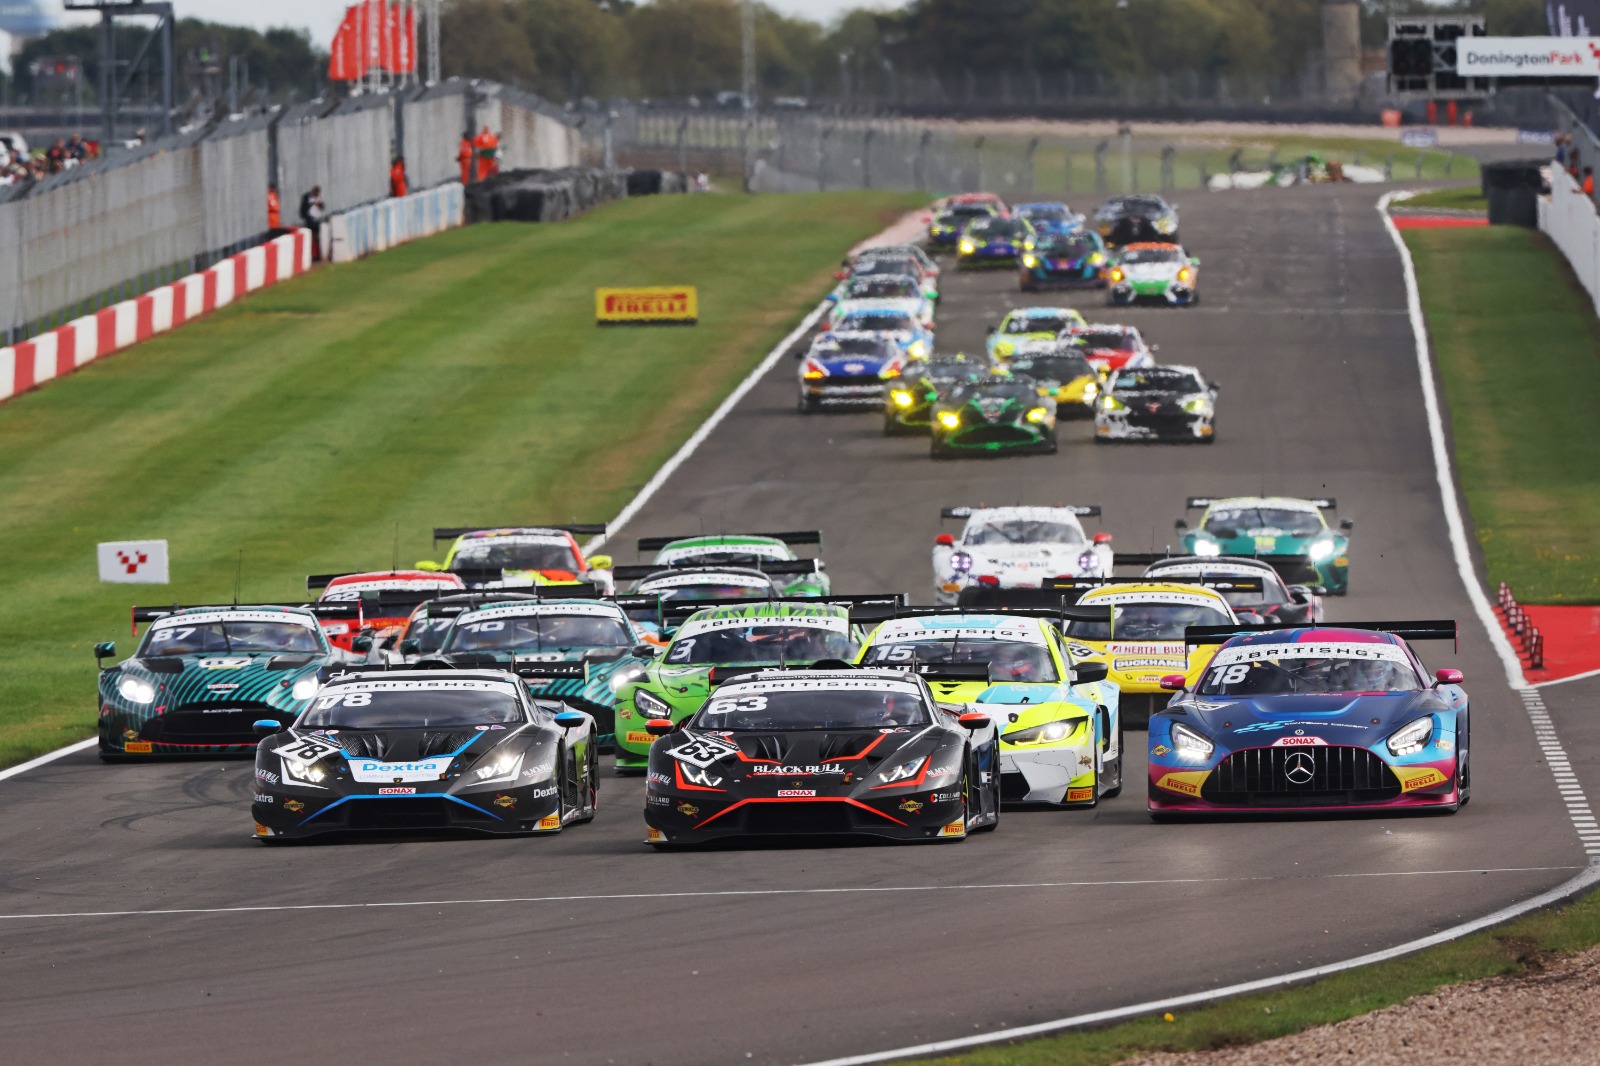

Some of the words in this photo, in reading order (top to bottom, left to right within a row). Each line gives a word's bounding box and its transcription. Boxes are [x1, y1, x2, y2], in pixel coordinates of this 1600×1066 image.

[152, 627, 197, 642] 87
[464, 621, 505, 633] 10
[670, 639, 697, 660] 3
[876, 645, 916, 661] 15
[1124, 646, 1157, 654] HERTH
[1235, 647, 1385, 661] #BRITISHGT
[1116, 659, 1186, 668] DUCKHAMS
[1211, 664, 1251, 686] 18
[316, 692, 373, 710] 78
[708, 696, 768, 715] 63
[677, 740, 727, 761] 63
[362, 763, 437, 772] Dextra
[753, 764, 803, 773] BLACK
[805, 763, 845, 775] BULL
[1166, 777, 1198, 794] PIRELLI
[1404, 773, 1436, 789] PIRELLI
